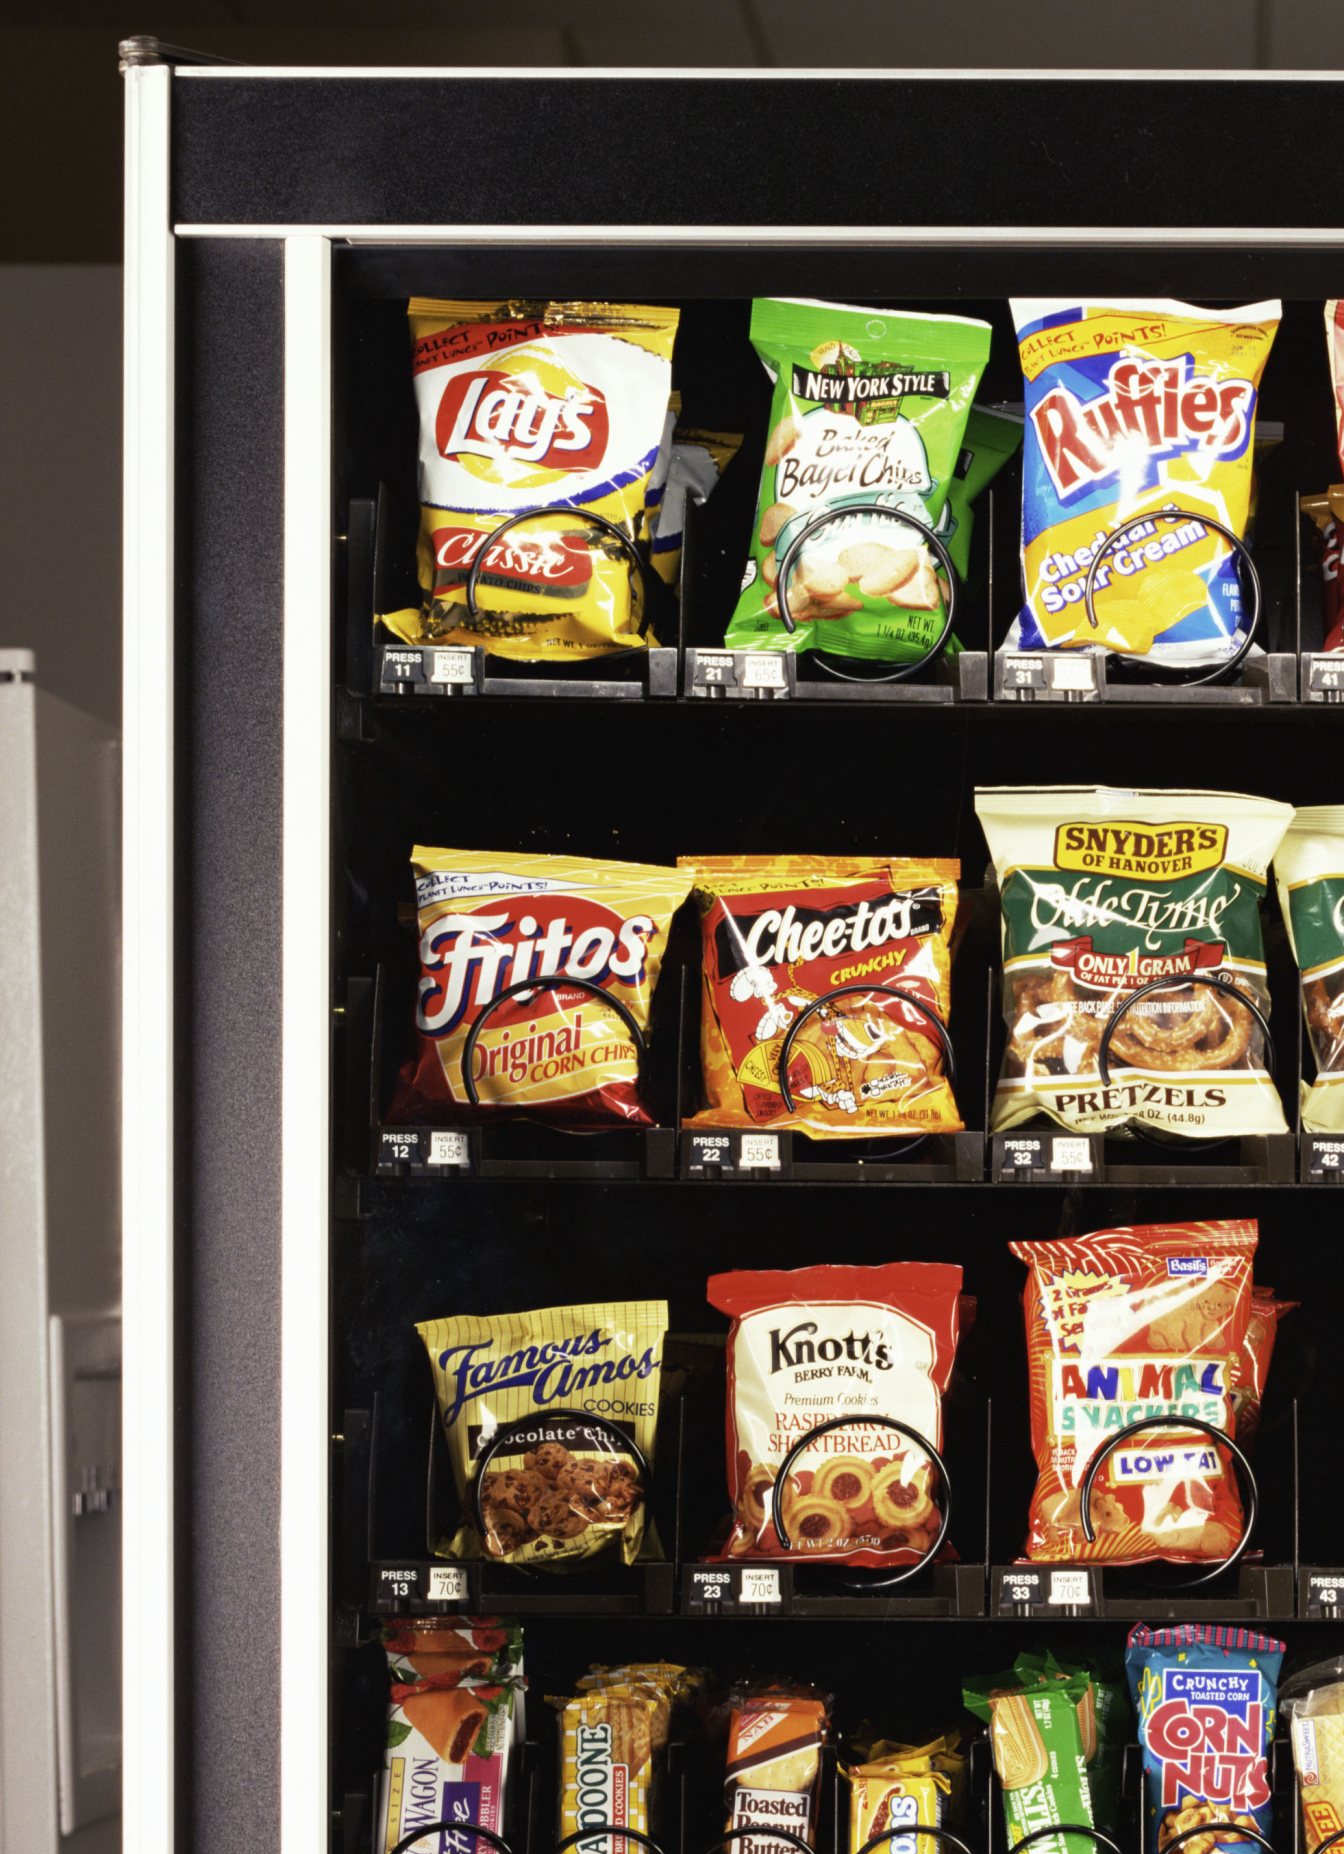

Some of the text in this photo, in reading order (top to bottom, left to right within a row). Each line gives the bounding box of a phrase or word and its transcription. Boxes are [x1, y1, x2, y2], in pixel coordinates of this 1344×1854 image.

[806, 373, 935, 401] NEW YORK STYLE
[1030, 357, 1252, 498] Ruffles
[438, 532, 573, 577] Classic
[1063, 826, 1219, 859] SNYDER'S
[1082, 854, 1193, 872] OF HANOVER
[419, 914, 653, 1030] Fritos
[830, 948, 907, 986] CRUNCHY
[1078, 947, 1191, 976] ONLY 1 GRAM
[474, 1013, 581, 1083] Original
[530, 1042, 636, 1080] CORN CHIPS
[1055, 1083, 1228, 1114] PRETZELS
[383, 1134, 418, 1143] PRESS
[392, 1146, 408, 1157] 12
[434, 1134, 465, 1143] INSERT
[439, 1144, 462, 1159] 55¢
[769, 1321, 895, 1375] Knott's
[439, 1328, 610, 1428] Famous
[1061, 1363, 1223, 1400] ANIMAL
[583, 1398, 655, 1417] COOKIES
[783, 1392, 879, 1408] Premium Cookies
[1172, 1675, 1249, 1692] CRUNCHY
[1190, 1691, 1228, 1700] TOASTED
[1146, 1699, 1263, 1761] CORN
[404, 1757, 440, 1834] WAGON
[579, 1726, 609, 1832] DOONE
[614, 1770, 625, 1816] COOKIES
[1162, 1753, 1271, 1812] NUTS
[737, 1792, 807, 1817] Toasted
